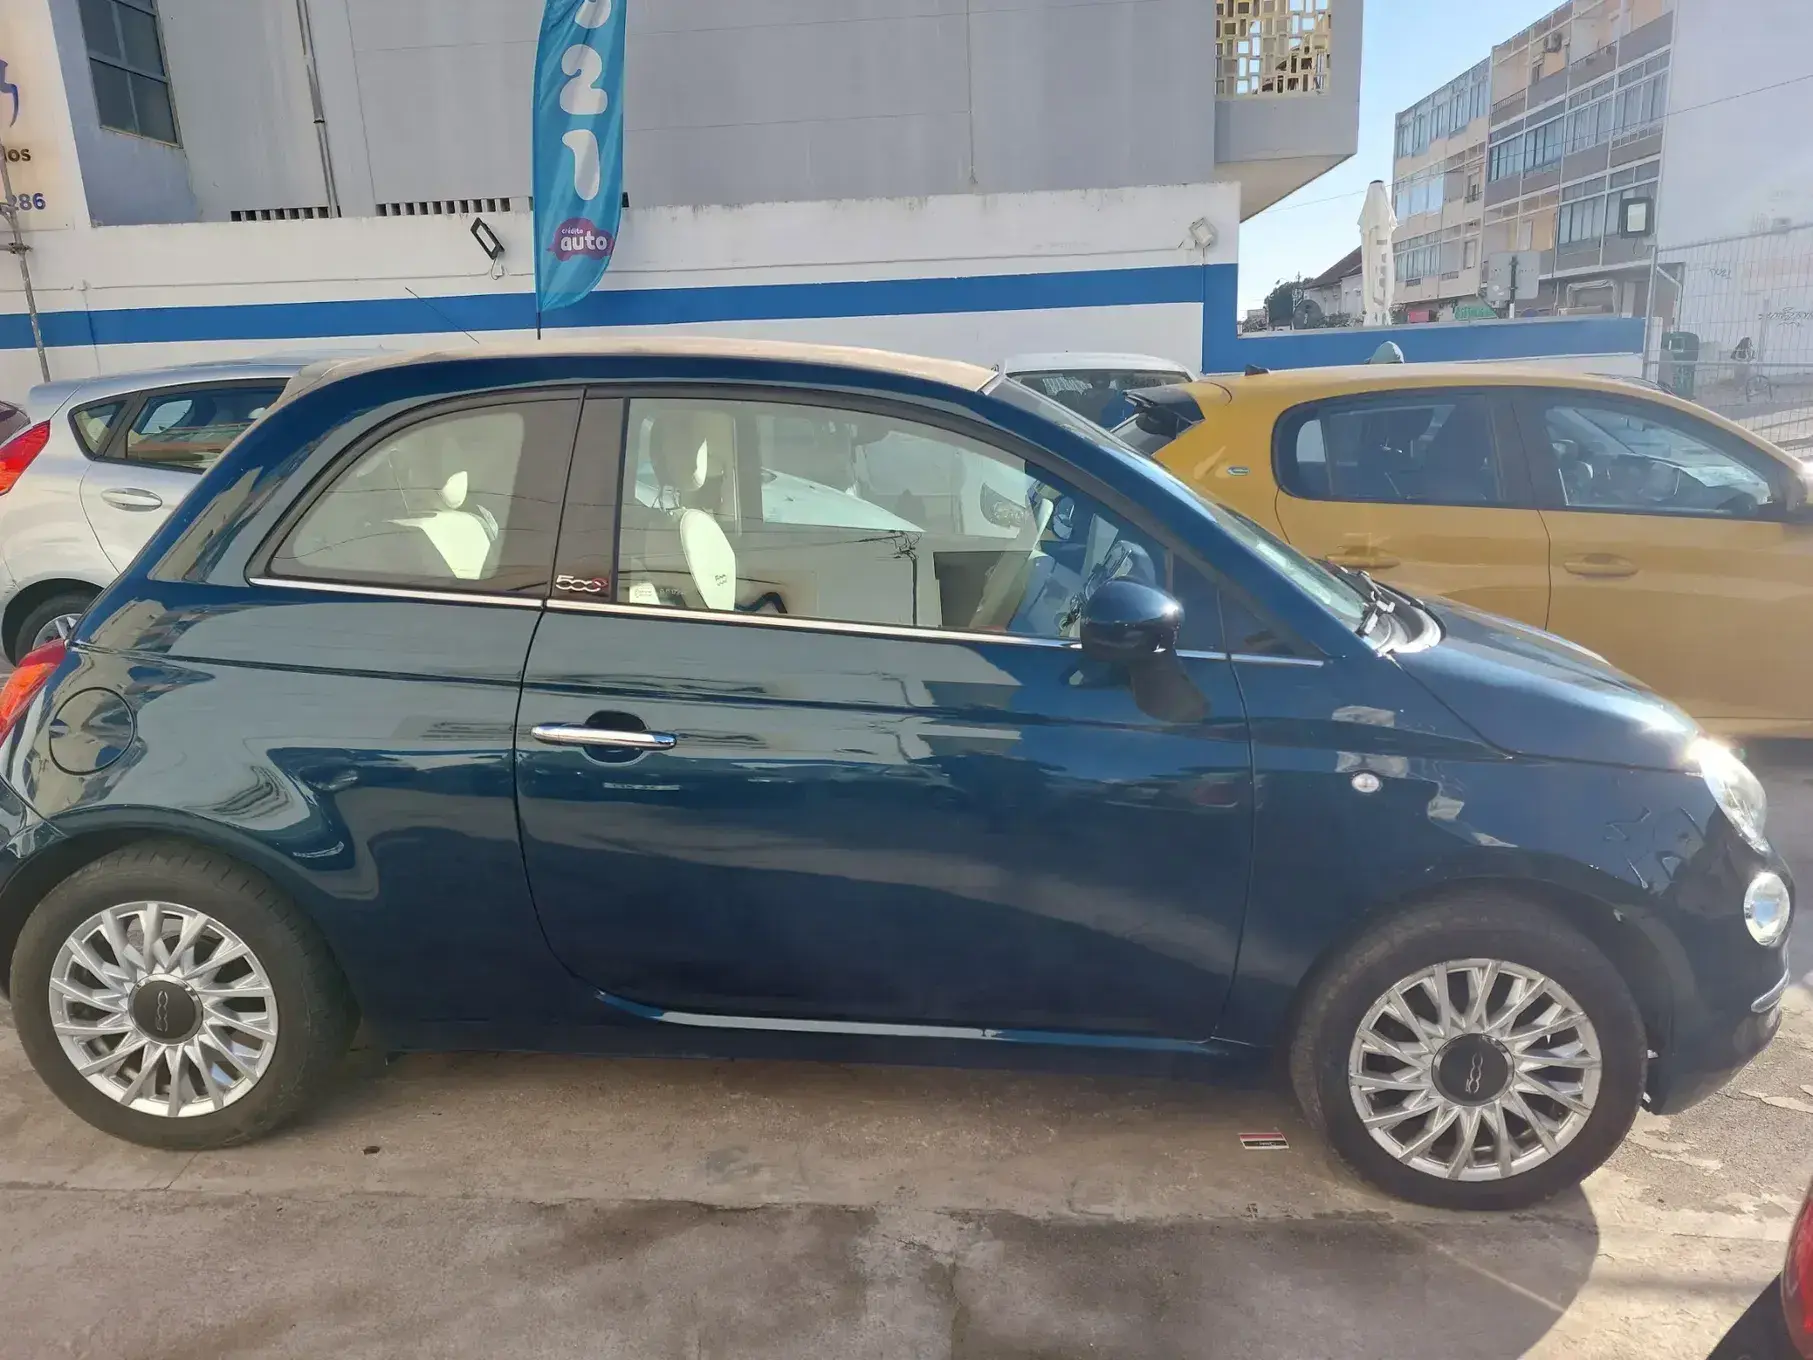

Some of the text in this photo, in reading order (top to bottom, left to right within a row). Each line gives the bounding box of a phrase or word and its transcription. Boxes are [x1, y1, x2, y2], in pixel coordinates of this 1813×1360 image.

[6, 148, 31, 163] os
[561, 226, 584, 235] crédito
[560, 230, 608, 251] auto
